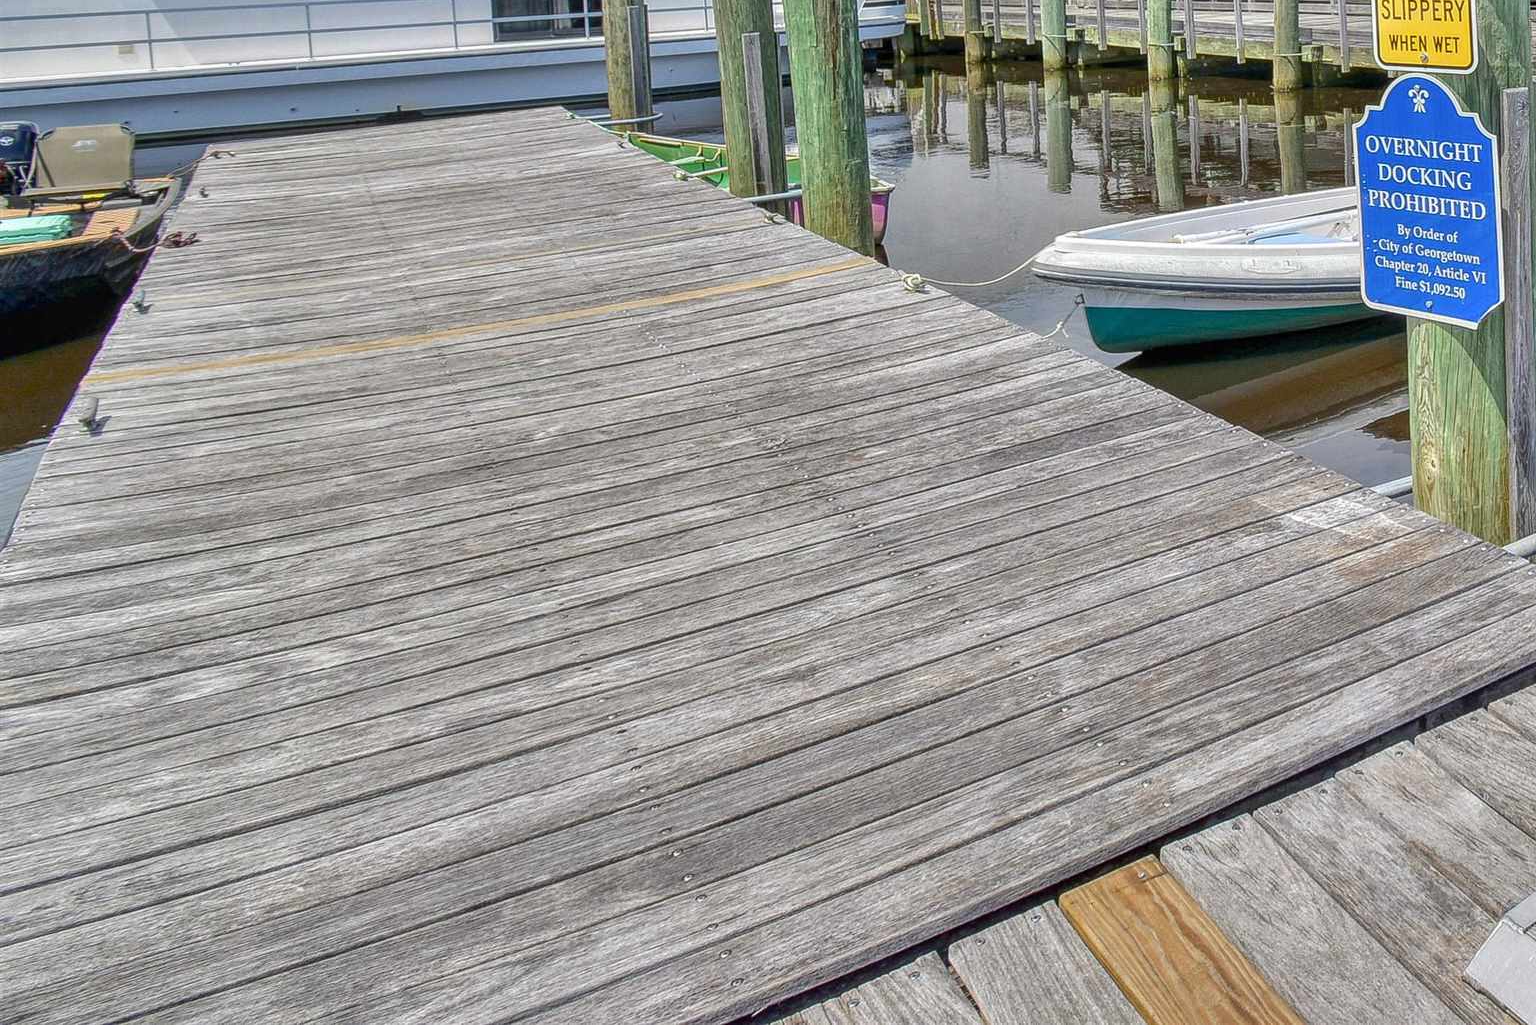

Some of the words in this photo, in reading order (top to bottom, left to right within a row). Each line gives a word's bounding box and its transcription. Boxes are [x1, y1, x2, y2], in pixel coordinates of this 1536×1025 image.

[1388, 34, 1427, 52] WHEN
[1433, 35, 1460, 54] WET
[1365, 135, 1483, 163] OVERNIGHT
[1377, 163, 1473, 190] DOCKING
[1367, 188, 1487, 220] PROHIBITED
[1396, 223, 1411, 239] By
[1413, 226, 1445, 242] Order
[1446, 231, 1459, 243] of
[1378, 238, 1400, 255] City
[1402, 242, 1414, 254] of
[1415, 244, 1481, 265] Georgetown
[1374, 255, 1416, 273] Chapter
[1417, 262, 1432, 277] 20,
[1433, 265, 1470, 282] Article
[1471, 270, 1487, 285] VI
[1394, 275, 1418, 290] Fine
[1419, 280, 1466, 299] $1,092.50
